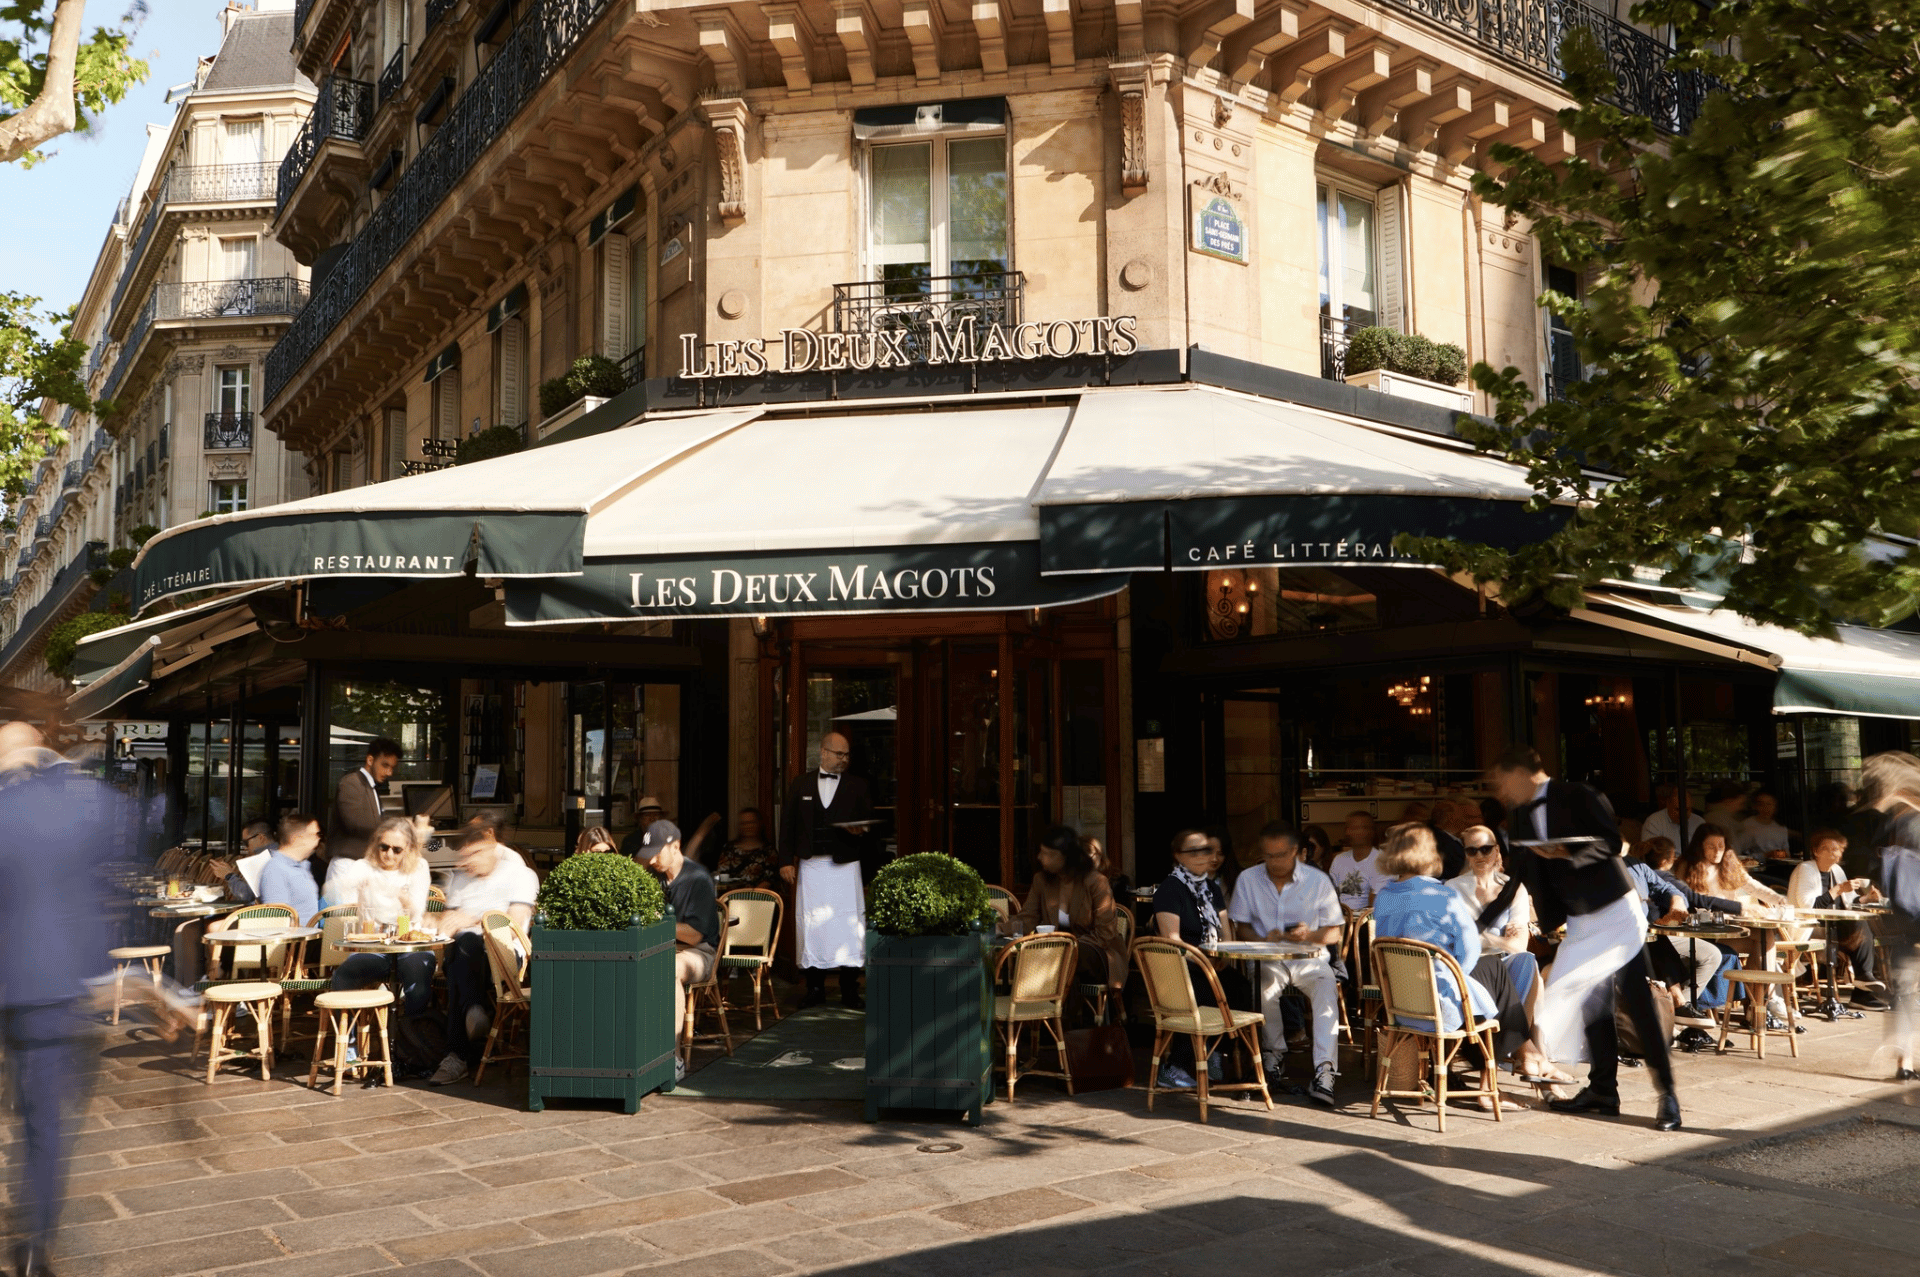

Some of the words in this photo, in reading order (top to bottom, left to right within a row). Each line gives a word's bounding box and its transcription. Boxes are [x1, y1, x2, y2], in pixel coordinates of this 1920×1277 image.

[679, 333, 767, 379] LES
[779, 327, 911, 374] DEUX
[927, 315, 1139, 364] MAGOTS
[313, 555, 455, 570] RESTAURANT
[1189, 540, 1255, 561] CAFÉ
[1273, 538, 1421, 559] LITTÉRAI
[629, 572, 697, 608] LES
[711, 568, 818, 606] DEUX
[828, 564, 997, 602] MAGOTS
